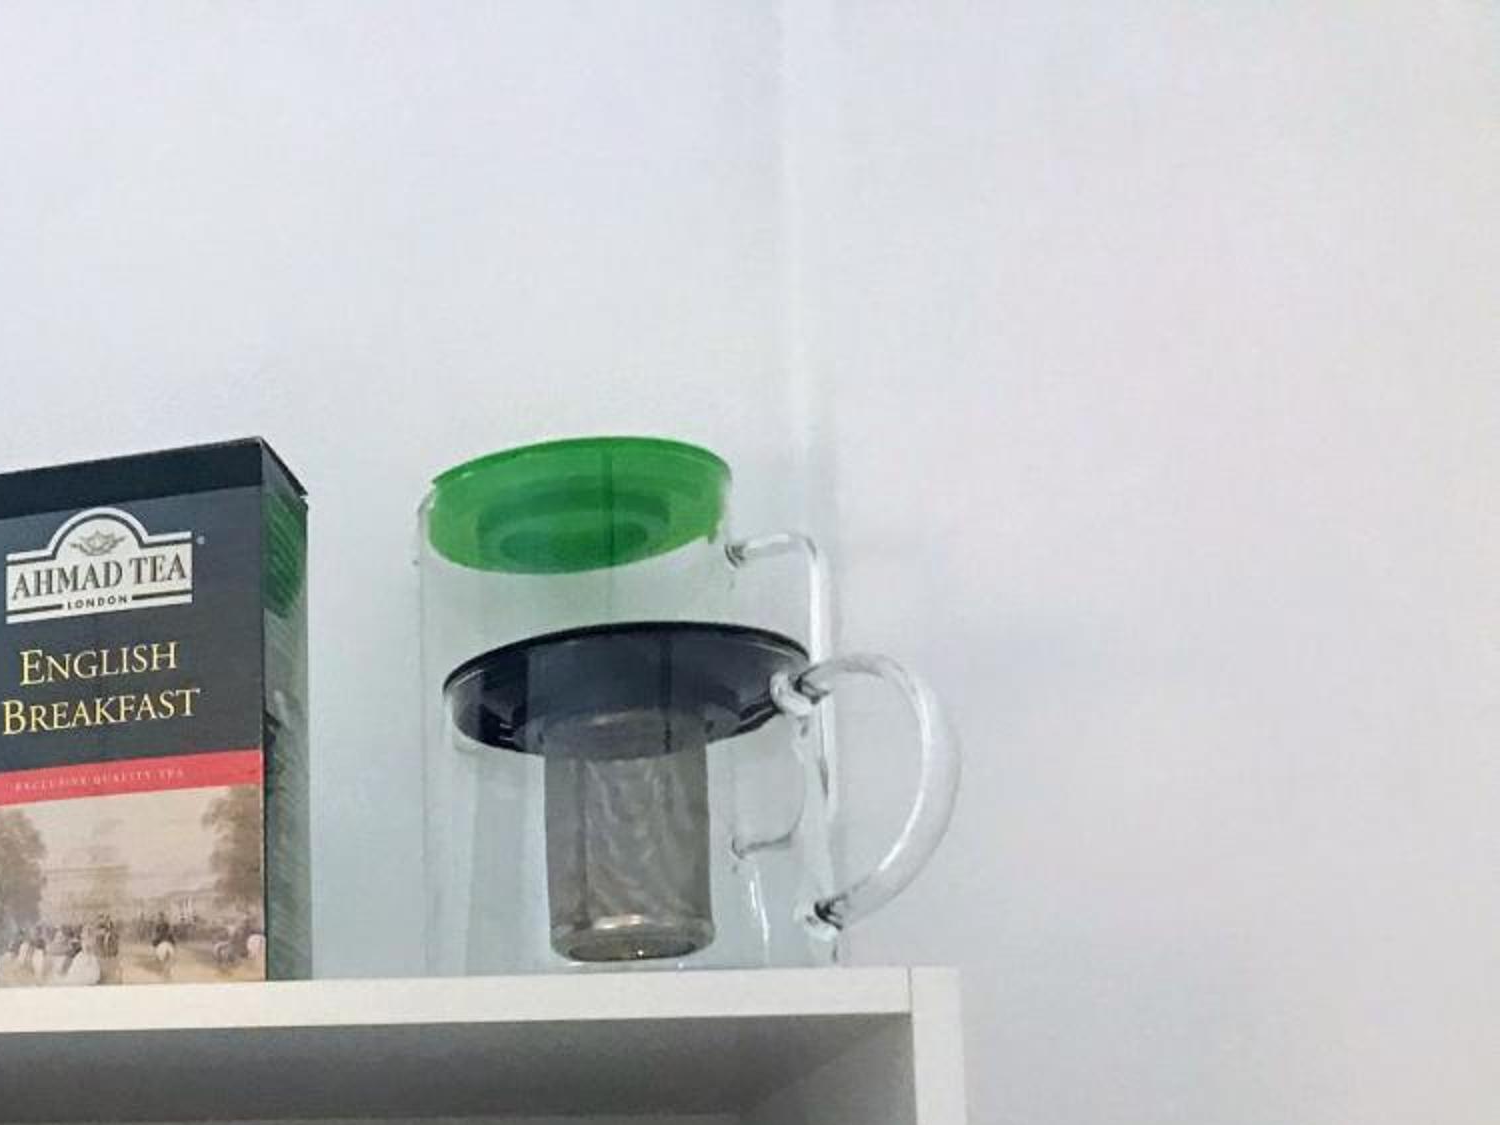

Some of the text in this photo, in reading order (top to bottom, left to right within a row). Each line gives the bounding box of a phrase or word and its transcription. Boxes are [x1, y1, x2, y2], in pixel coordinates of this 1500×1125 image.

[13, 552, 186, 600] AHMAD TEA
[67, 595, 128, 611] LONDON
[20, 641, 178, 687] ENGLISH
[3, 687, 200, 736] BREAKFAST
[93, 769, 151, 786] QUALITY
[159, 766, 185, 781] TEA
